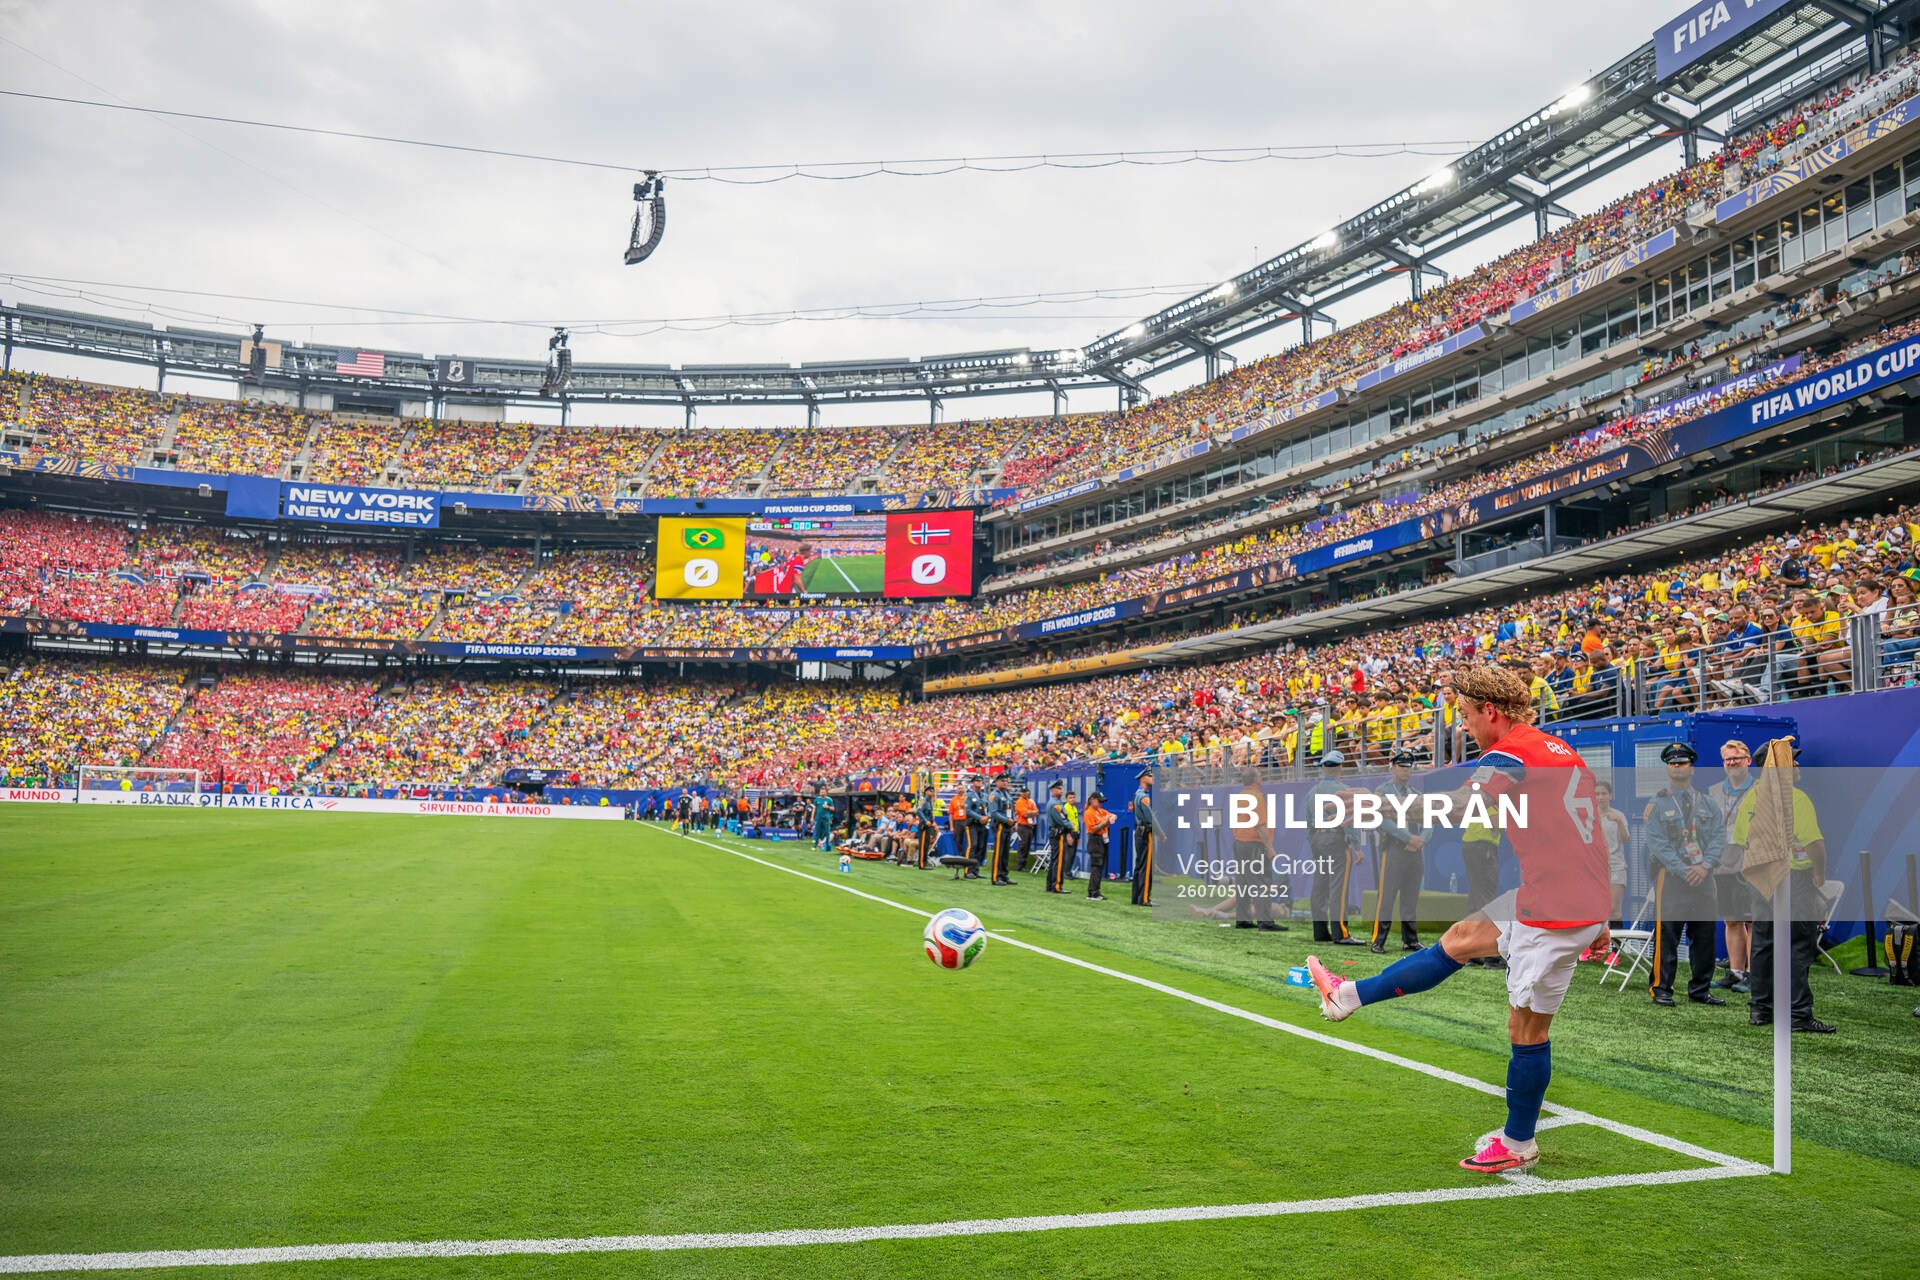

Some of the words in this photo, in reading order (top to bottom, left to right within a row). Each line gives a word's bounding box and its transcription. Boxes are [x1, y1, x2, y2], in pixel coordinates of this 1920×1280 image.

[1673, 1, 1731, 54] FIFA
[1751, 392, 1794, 425] FIFA
[1795, 363, 1873, 408] WORLD
[1876, 343, 1920, 378] CUP
[1494, 489, 1520, 510] NEW
[1521, 480, 1552, 501] YORK
[1552, 469, 1581, 492] NEW
[1582, 452, 1629, 482] JERSEY
[289, 487, 354, 505] NEW
[359, 493, 435, 510] YORK
[764, 505, 781, 514] FIFA
[782, 505, 809, 513] WORLD
[809, 505, 824, 513] CUP
[825, 504, 852, 512] 2026
[288, 504, 341, 519] NEW
[345, 509, 434, 525] JERSEY
[1042, 620, 1056, 632] FIFA
[1056, 615, 1080, 629] WORLD
[1080, 612, 1093, 624] CUP
[1092, 606, 1116, 621] 2026
[465, 645, 486, 655] FIFA
[486, 645, 522, 655] WORLD
[522, 646, 542, 656] CUP
[542, 646, 577, 657] 2026
[9, 790, 61, 801] MUNDO
[140, 792, 193, 805] BANK
[228, 795, 313, 809] AMERICA
[1563, 765, 1595, 845] 6
[419, 802, 483, 814] SIRVIENDO
[487, 804, 502, 815] AL
[506, 805, 551, 816] MUNDO
